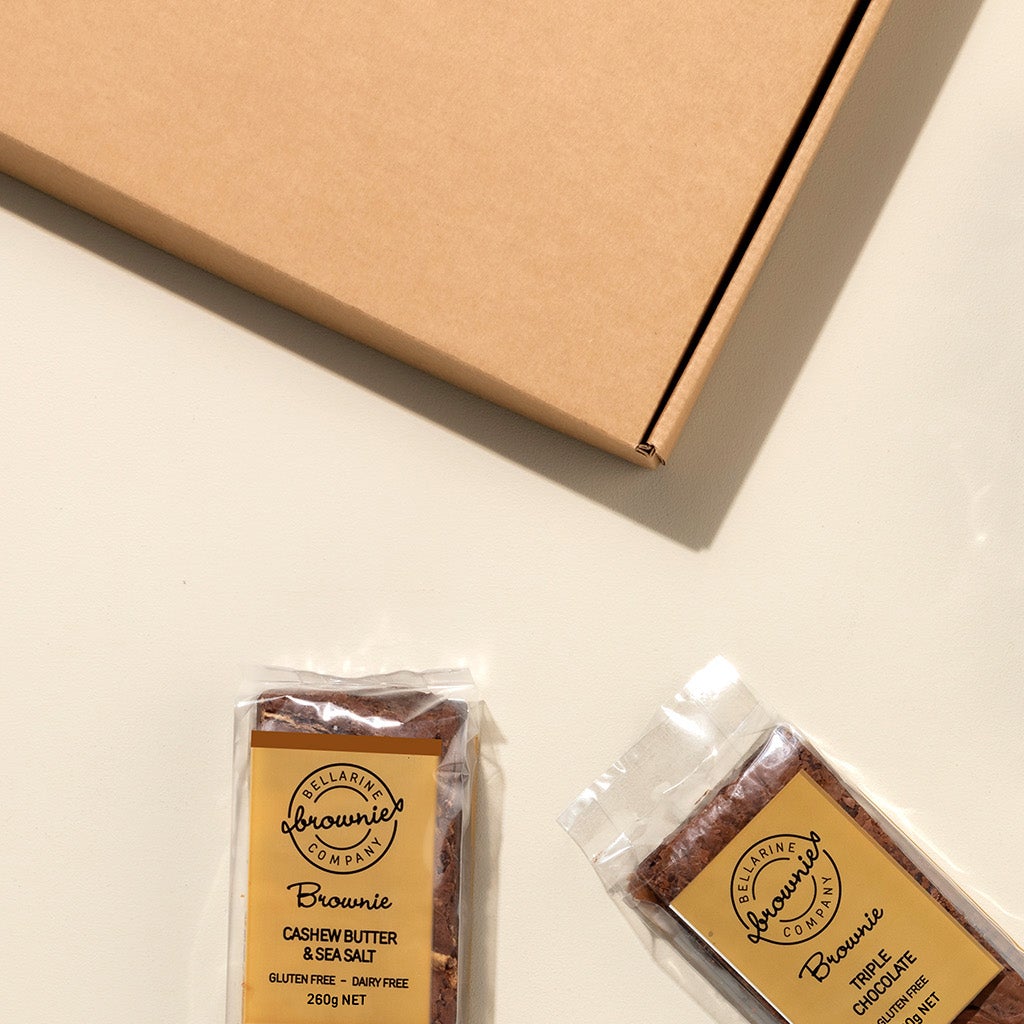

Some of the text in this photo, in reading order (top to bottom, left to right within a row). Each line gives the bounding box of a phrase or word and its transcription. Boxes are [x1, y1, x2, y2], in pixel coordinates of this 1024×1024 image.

[302, 771, 383, 800] BELLARINE
[289, 803, 395, 833] brownie
[308, 837, 381, 866] COMPANY
[738, 842, 796, 903] BELLARINE
[287, 882, 392, 910] Brownie
[747, 847, 819, 933] brownie
[783, 876, 833, 937] COMPANY
[283, 927, 397, 945] CASHEW BUTTER
[798, 907, 883, 983] Brownie
[303, 947, 376, 963] & SEA SALT
[269, 973, 308, 984] GLUTEN
[310, 974, 336, 985] FREE
[352, 976, 381, 987] DAIRY
[383, 978, 408, 988] FREE
[849, 949, 892, 991] TRIPLE
[853, 950, 917, 1016] CHOCOLATE
[307, 993, 366, 1007] 260g NET
[906, 975, 929, 998] FREE
[917, 992, 940, 1016] NET
